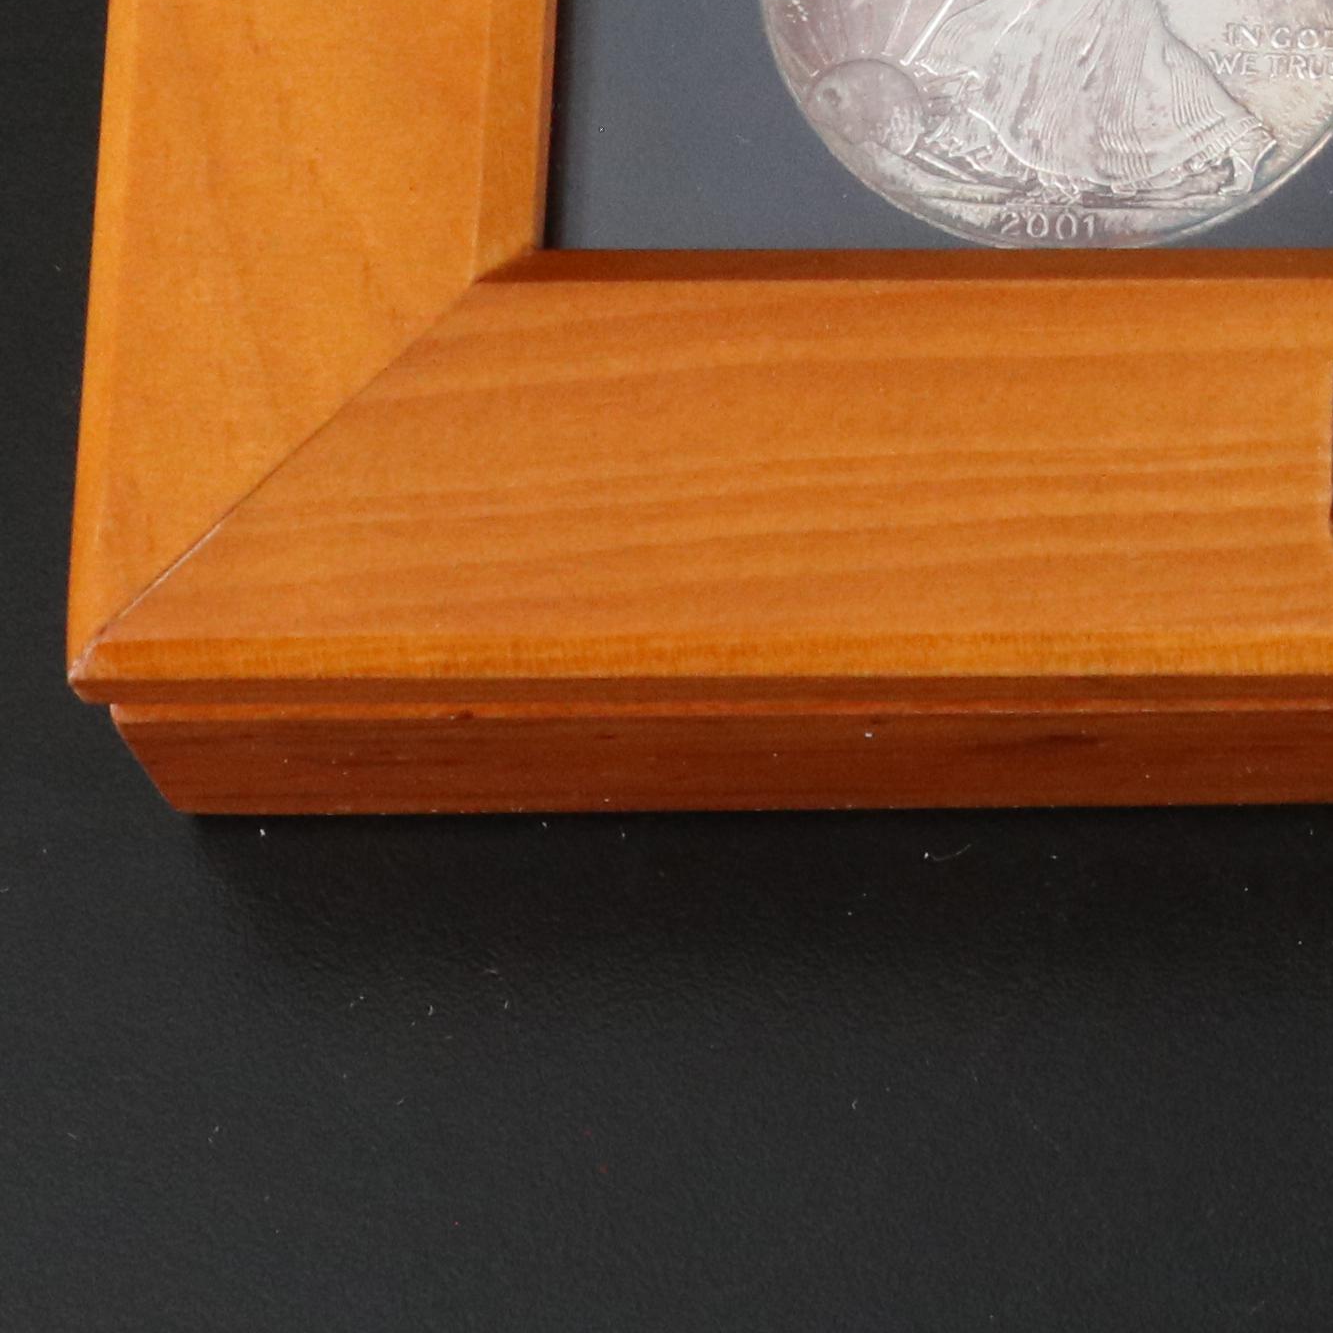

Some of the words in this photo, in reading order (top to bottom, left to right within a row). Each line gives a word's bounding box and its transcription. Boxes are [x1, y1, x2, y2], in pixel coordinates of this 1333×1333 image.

[1226, 22, 1263, 47] IN
[1208, 51, 1259, 75] WE
[1000, 211, 1095, 240] 2001
